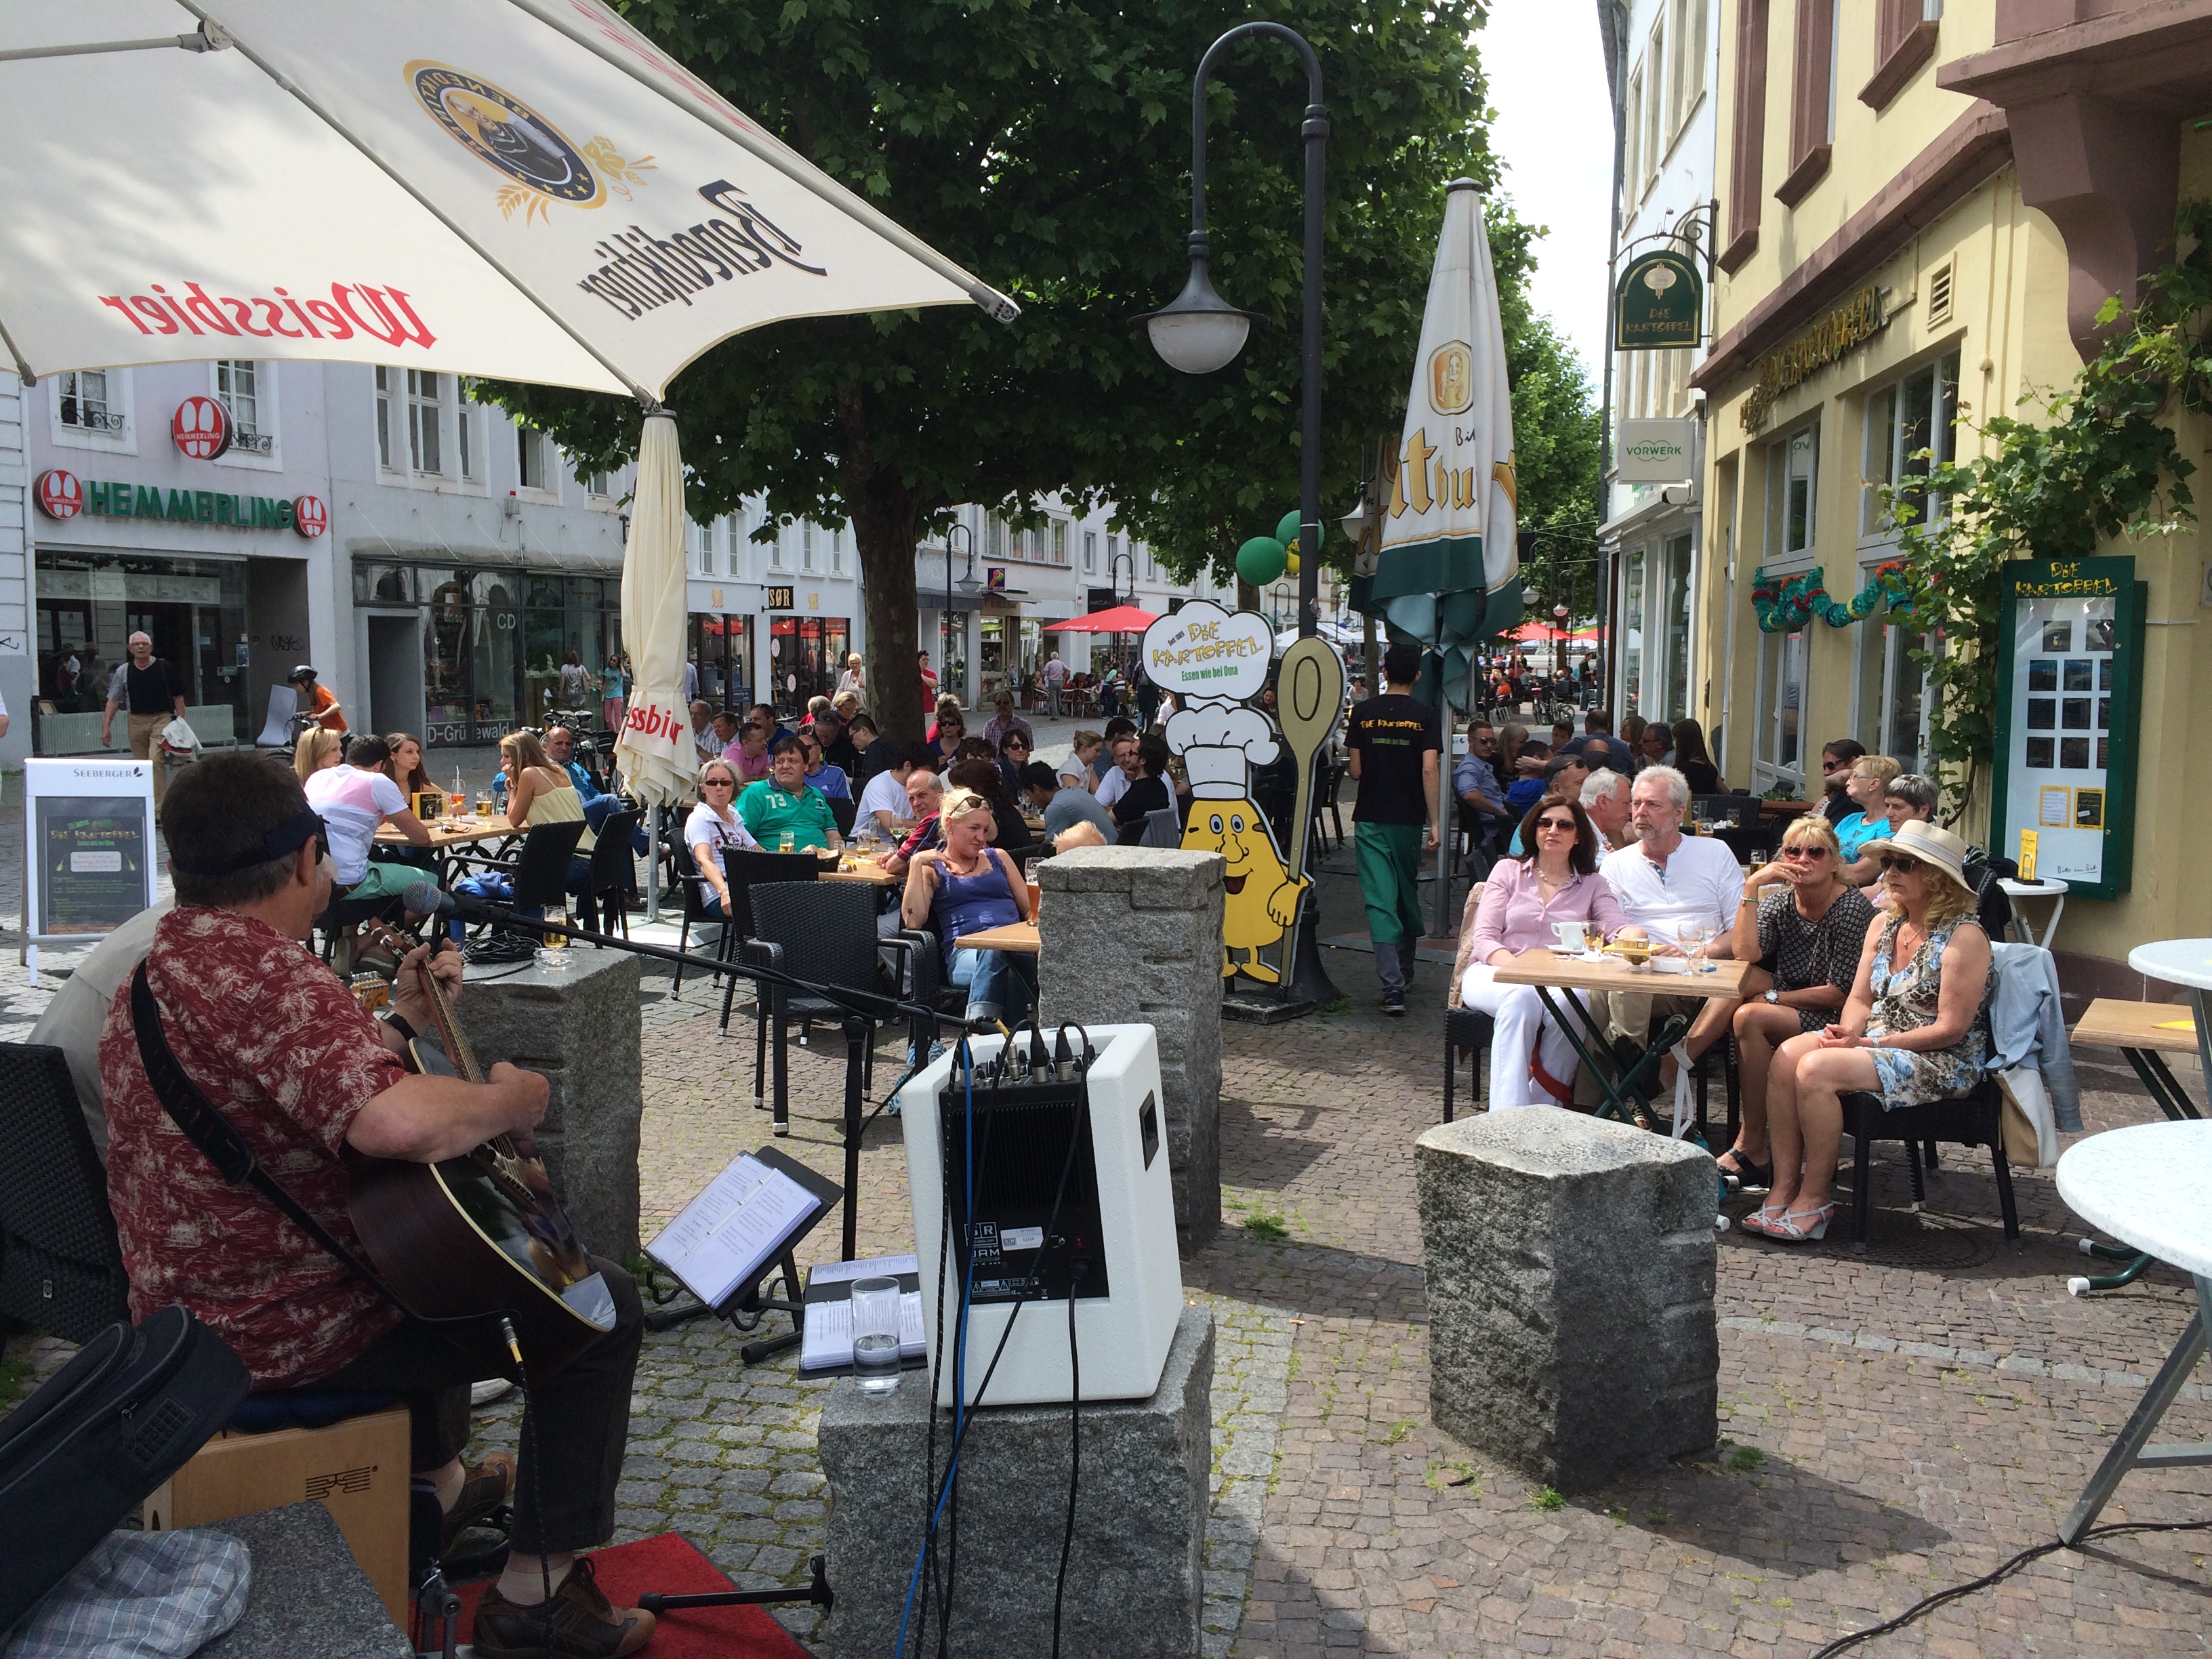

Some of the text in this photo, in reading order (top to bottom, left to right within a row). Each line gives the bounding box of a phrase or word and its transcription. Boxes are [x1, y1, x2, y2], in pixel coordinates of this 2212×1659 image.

[176, 432, 220, 441] HEMMERLING
[1626, 446, 1681, 455] VORWERK
[88, 480, 294, 529] HEMMERLING
[2015, 577, 2118, 596] KARTOFFEL
[769, 588, 790, 607] SØR
[497, 613, 516, 630] CD
[1153, 636, 1264, 668] KARTOFFEL
[1181, 665, 1238, 682] Essen wie bei Oma
[765, 793, 787, 809] 73
